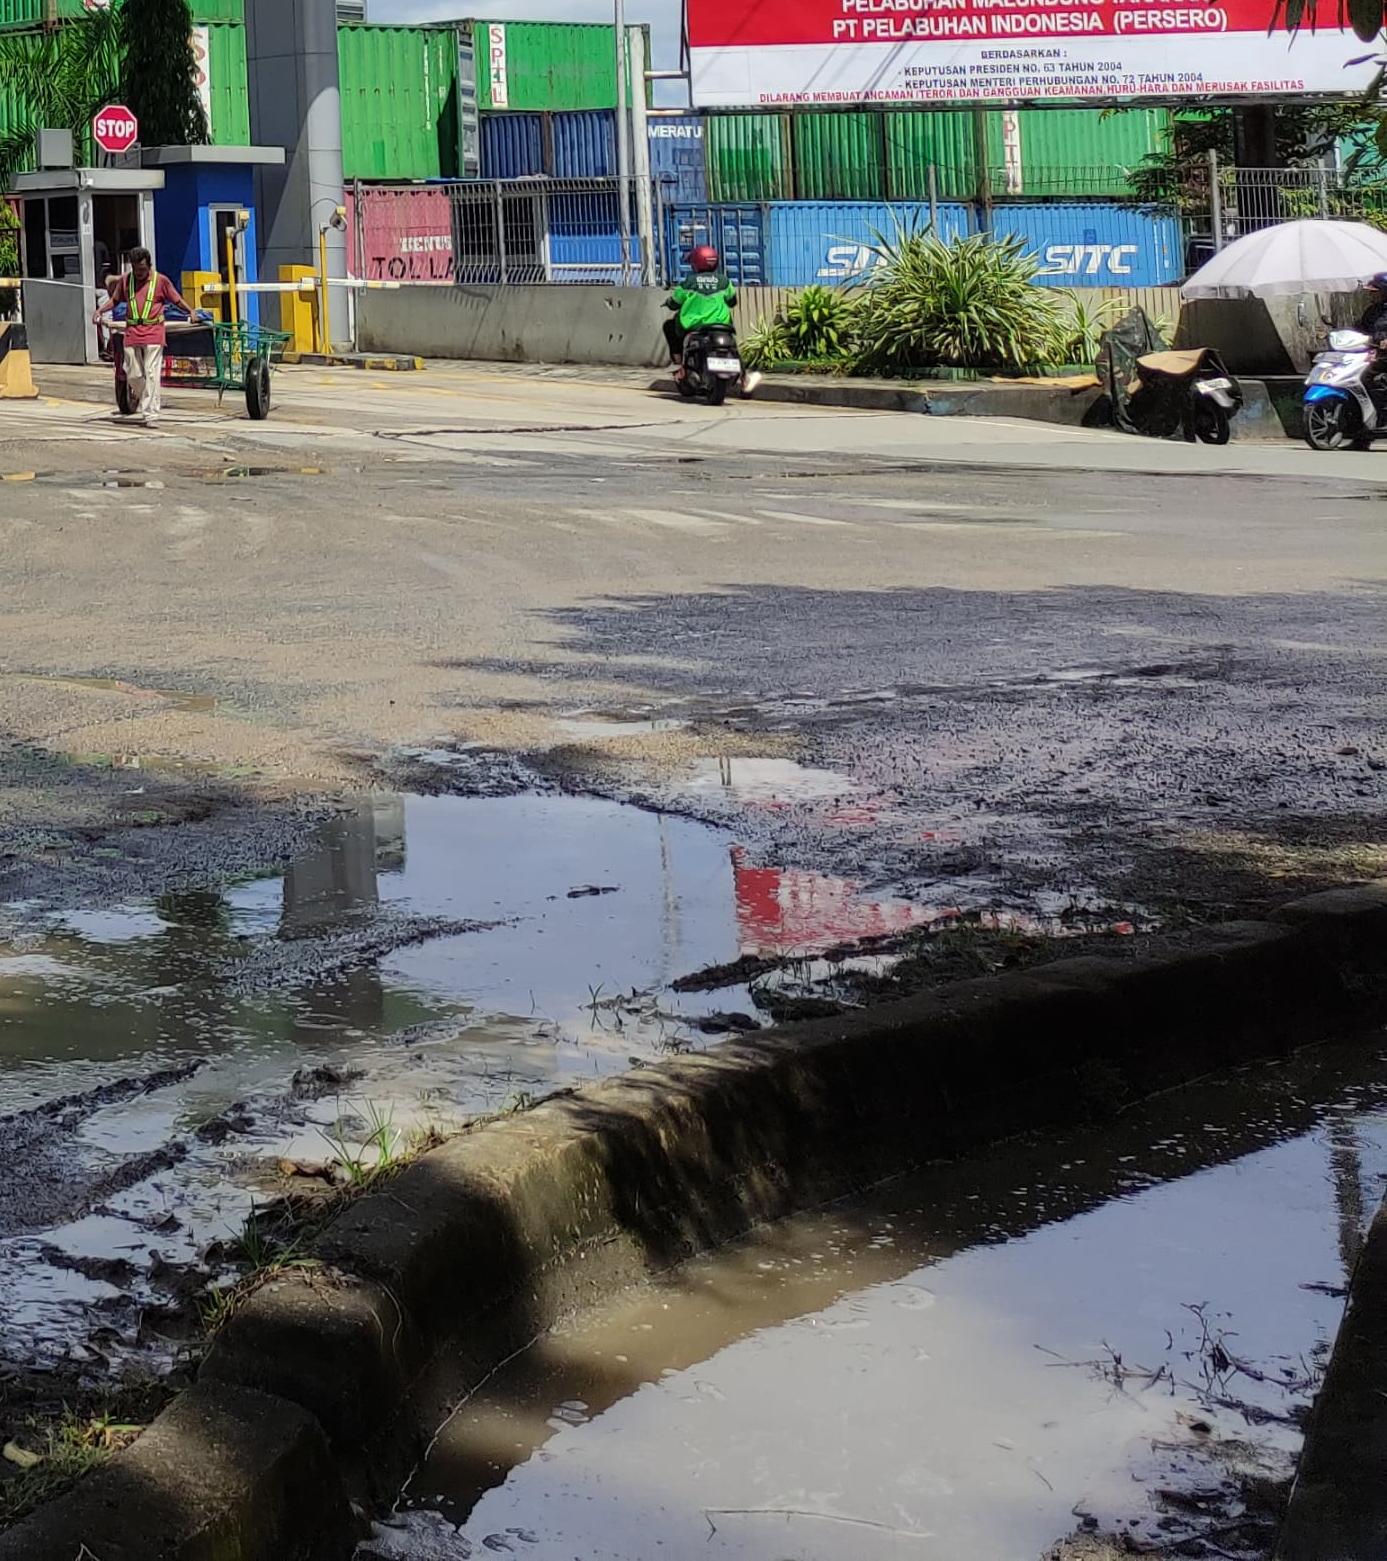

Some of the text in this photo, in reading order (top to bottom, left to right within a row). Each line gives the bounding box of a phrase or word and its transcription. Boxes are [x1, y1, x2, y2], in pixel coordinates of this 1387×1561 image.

[832, 8, 1228, 38] PT PELABUHAN INDONESIA (PERSERO)
[981, 49, 1060, 59] BERDASARKAN
[489, 27, 507, 104] SPIL
[904, 65, 966, 77] KEPUTUSAN
[969, 64, 1020, 75] PRESIDEN
[1022, 64, 1041, 73] NO.
[1058, 62, 1095, 72] TAHUN
[1098, 61, 1122, 71] 2004
[905, 79, 967, 89] KEPUTUSAN
[970, 78, 1017, 88] MENTERI
[1019, 75, 1099, 86] PERHUBUNGAN
[1102, 75, 1120, 85] NO.
[1122, 74, 1136, 84] 72
[1139, 73, 1175, 83] TAHUN
[1178, 72, 1203, 82] 2004
[759, 92, 811, 103] DILARANG
[813, 91, 862, 102] MEMBUAT
[864, 90, 915, 101] ANCAMAN
[959, 88, 980, 98] DAN
[983, 86, 1042, 98] GANGGUAN
[1172, 82, 1194, 92] DAN
[1196, 81, 1248, 92] MERUSAK
[1250, 79, 1305, 90] FASILITAS
[97, 119, 135, 138] STOP
[647, 124, 704, 139] MERATU
[1037, 244, 1139, 275] SITC
